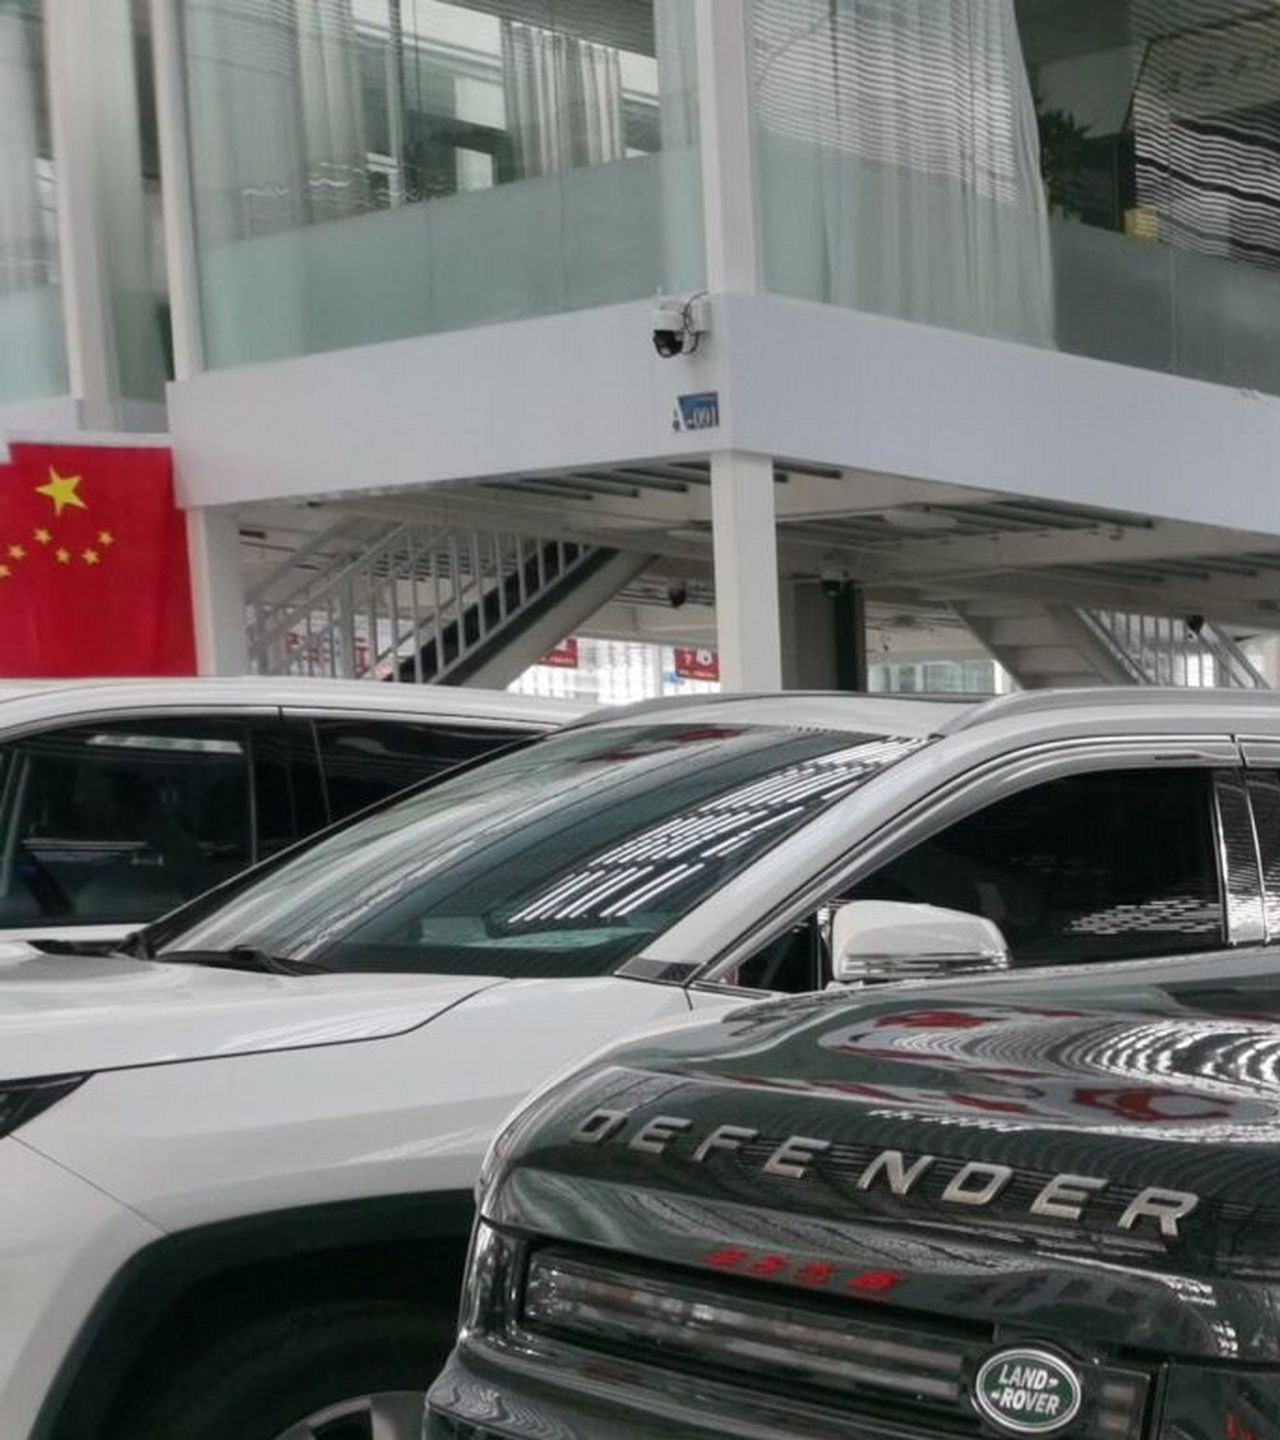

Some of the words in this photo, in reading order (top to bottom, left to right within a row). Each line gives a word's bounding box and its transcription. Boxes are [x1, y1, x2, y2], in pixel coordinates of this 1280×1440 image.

[570, 1109, 1199, 1237] DEFENDER
[998, 1362, 1049, 1391] LAND
[999, 1386, 1061, 1416] ROVER
